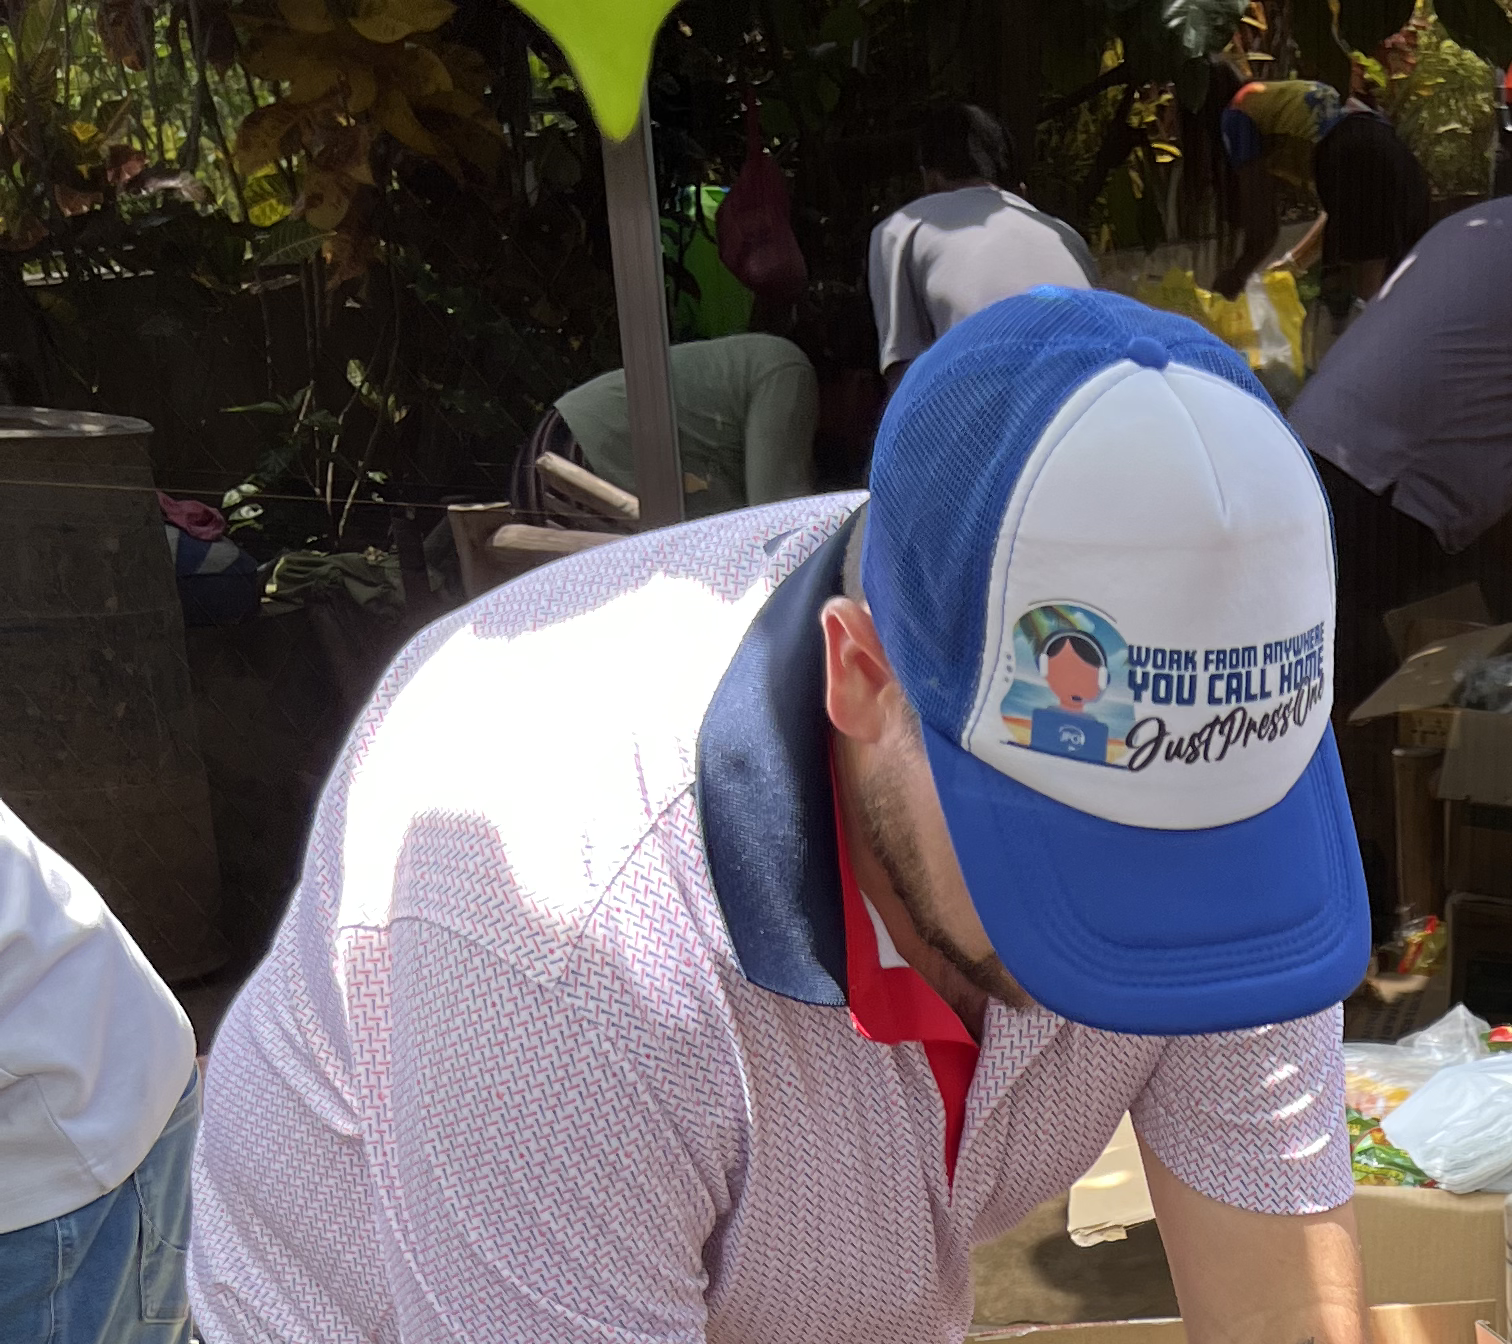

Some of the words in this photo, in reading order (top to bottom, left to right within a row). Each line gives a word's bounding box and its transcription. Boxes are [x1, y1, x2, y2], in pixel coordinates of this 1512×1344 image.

[1128, 645, 1198, 672] WORK
[1204, 646, 1258, 672] FROM
[1263, 621, 1325, 665] ANYWHERE
[1128, 669, 1198, 706] YOU
[1208, 667, 1272, 705] CALL
[1279, 644, 1324, 696] HOME
